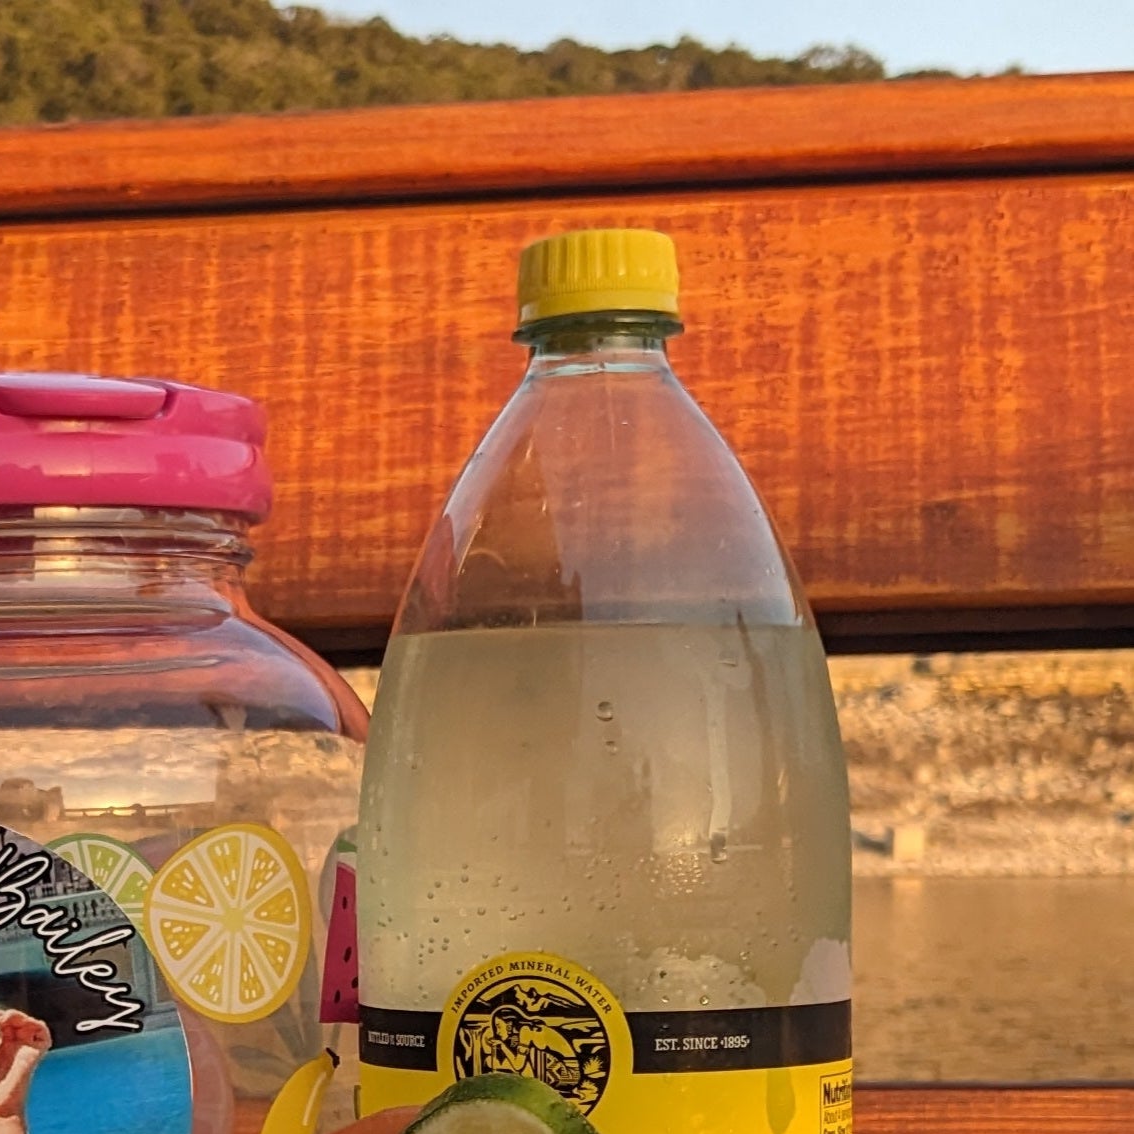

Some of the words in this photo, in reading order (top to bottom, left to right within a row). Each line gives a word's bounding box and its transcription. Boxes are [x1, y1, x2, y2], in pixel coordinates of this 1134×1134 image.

[451, 965, 504, 1014] IMPORTED
[508, 961, 571, 980] MINERAL
[574, 975, 613, 1015] WATER
[396, 1034, 426, 1048] SOURCE
[655, 1038, 680, 1052] EST.
[683, 1037, 719, 1051] SINCE
